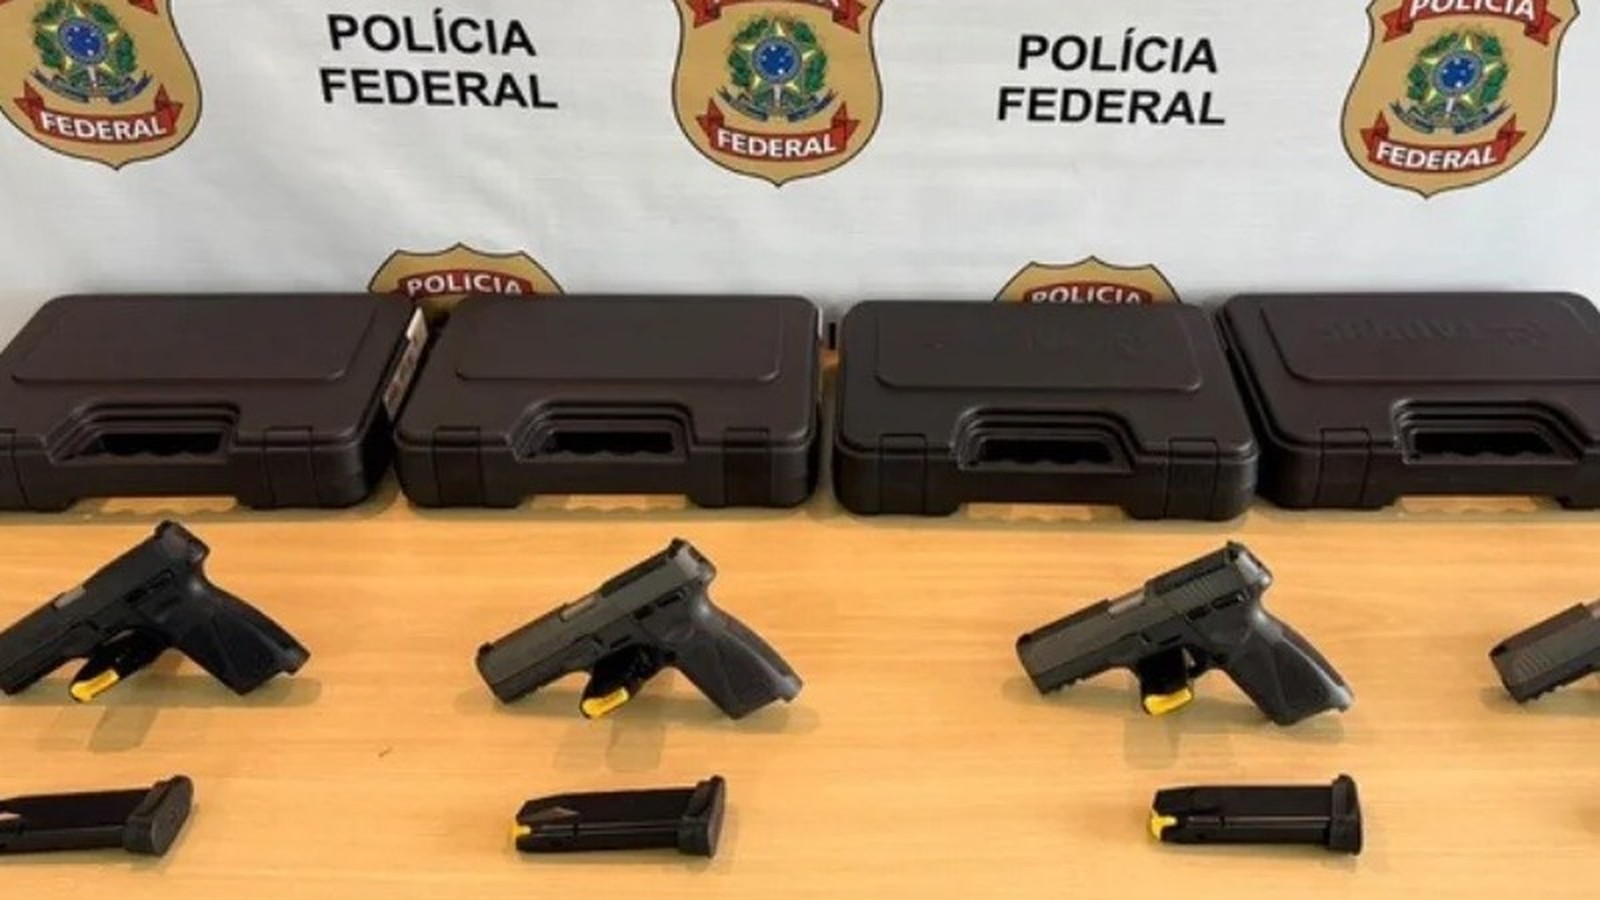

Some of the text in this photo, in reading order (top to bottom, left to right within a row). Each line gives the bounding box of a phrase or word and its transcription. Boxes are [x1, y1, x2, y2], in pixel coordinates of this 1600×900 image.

[328, 8, 537, 57] POLÍCIA
[1018, 28, 1217, 73] POLÍCIA
[319, 69, 558, 109] FEDERAL
[998, 87, 1225, 125] FEDERAL
[40, 110, 167, 141] FEDERAL
[717, 127, 837, 158] FEDERAL
[1376, 140, 1497, 170] FEDERAL
